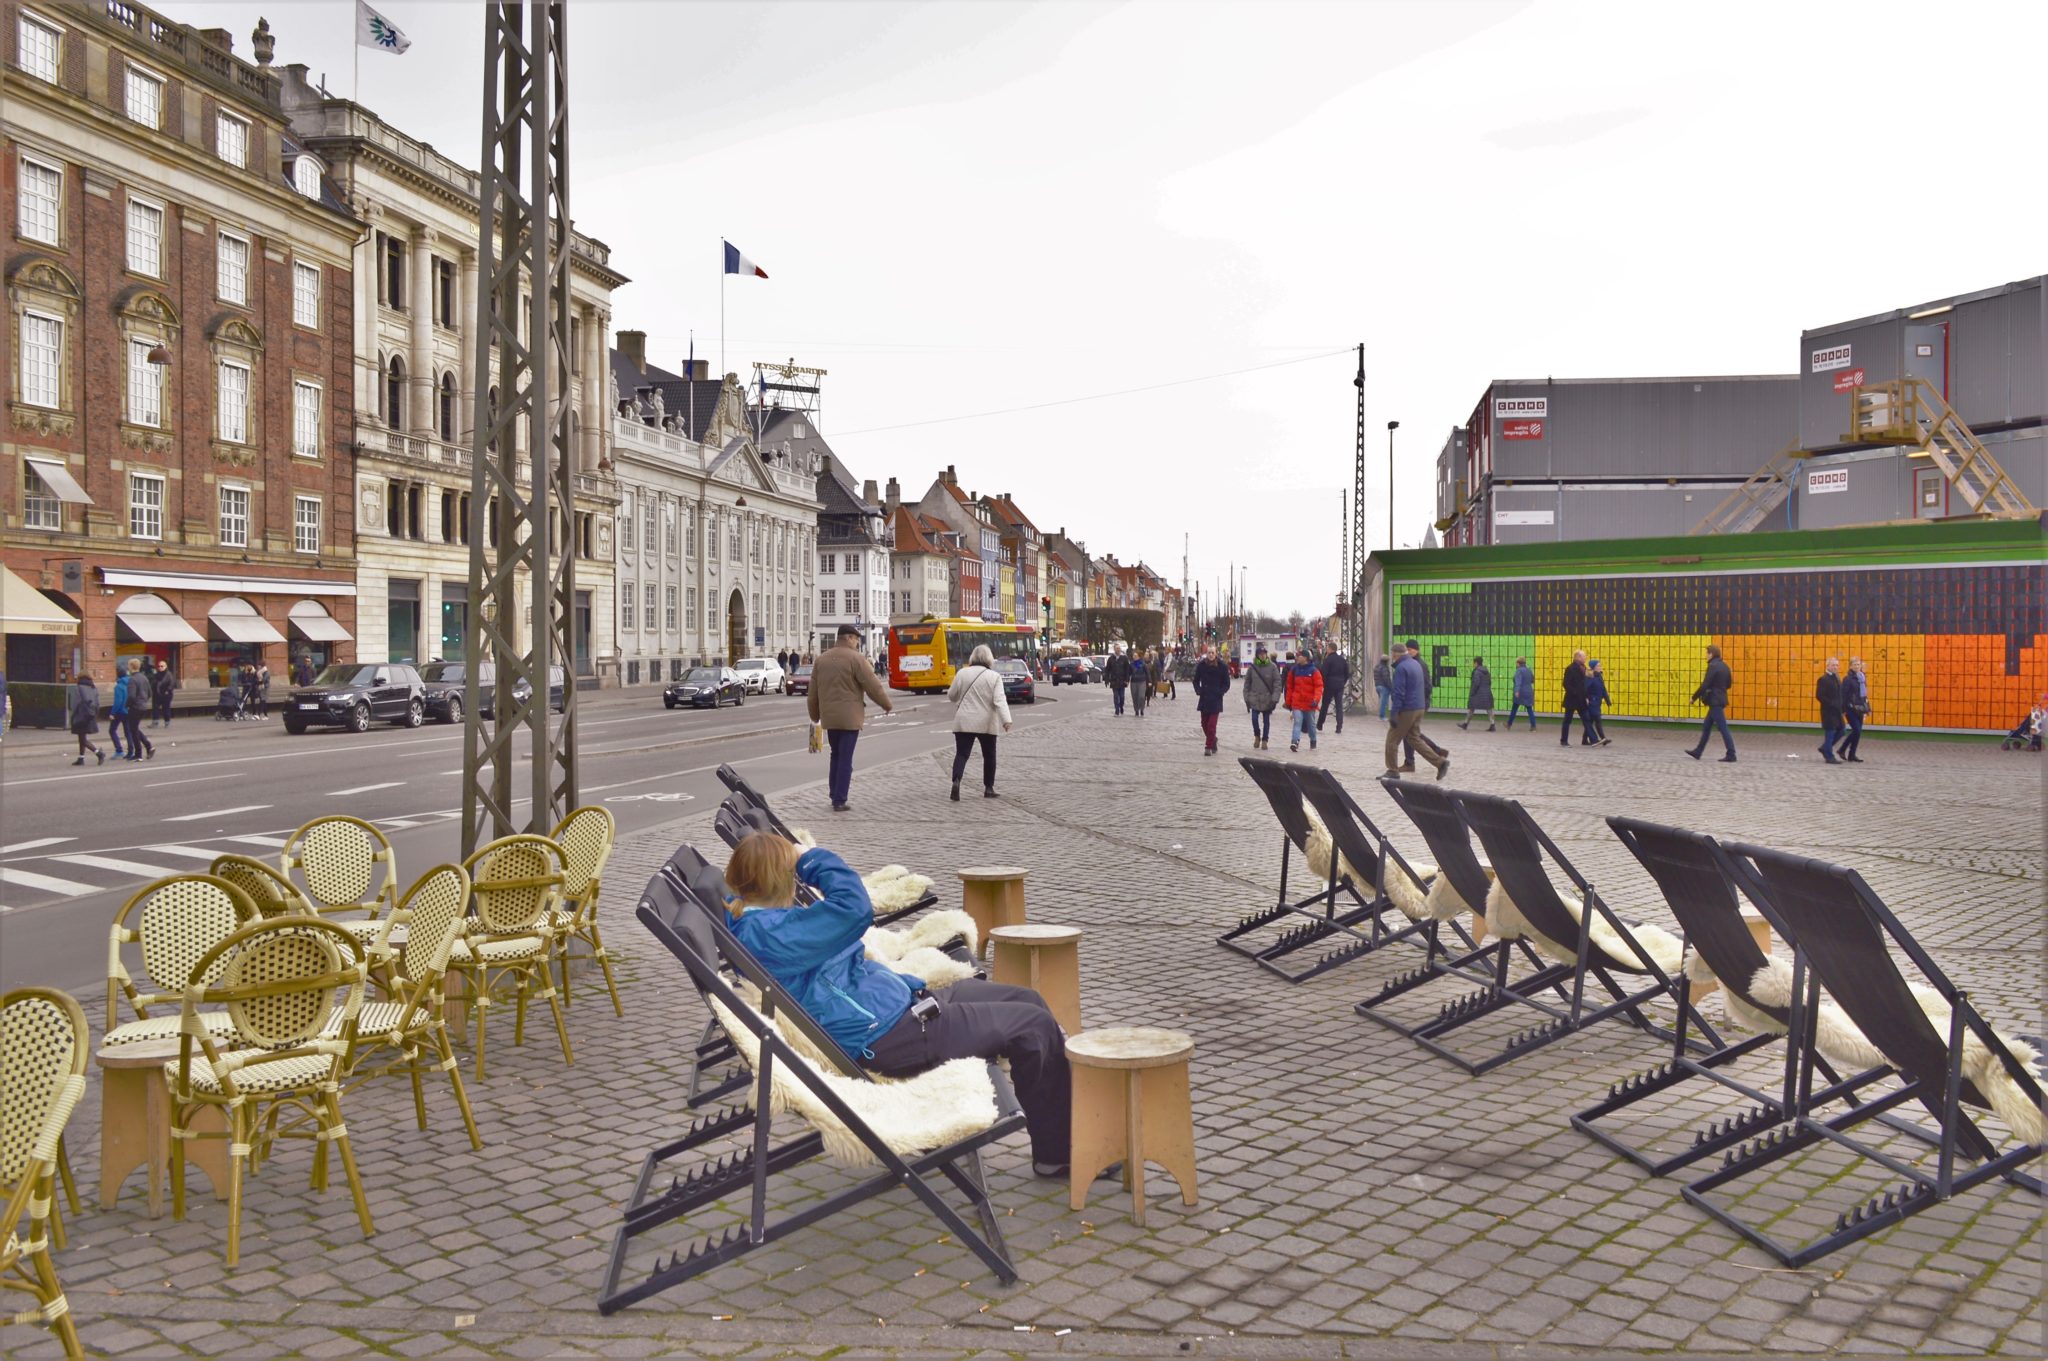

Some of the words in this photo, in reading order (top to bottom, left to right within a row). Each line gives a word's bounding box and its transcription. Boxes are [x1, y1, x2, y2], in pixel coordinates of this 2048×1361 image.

[1814, 348, 1849, 363] CRAMO
[793, 366, 827, 375] NARDIN
[1498, 402, 1544, 410] CRAMO
